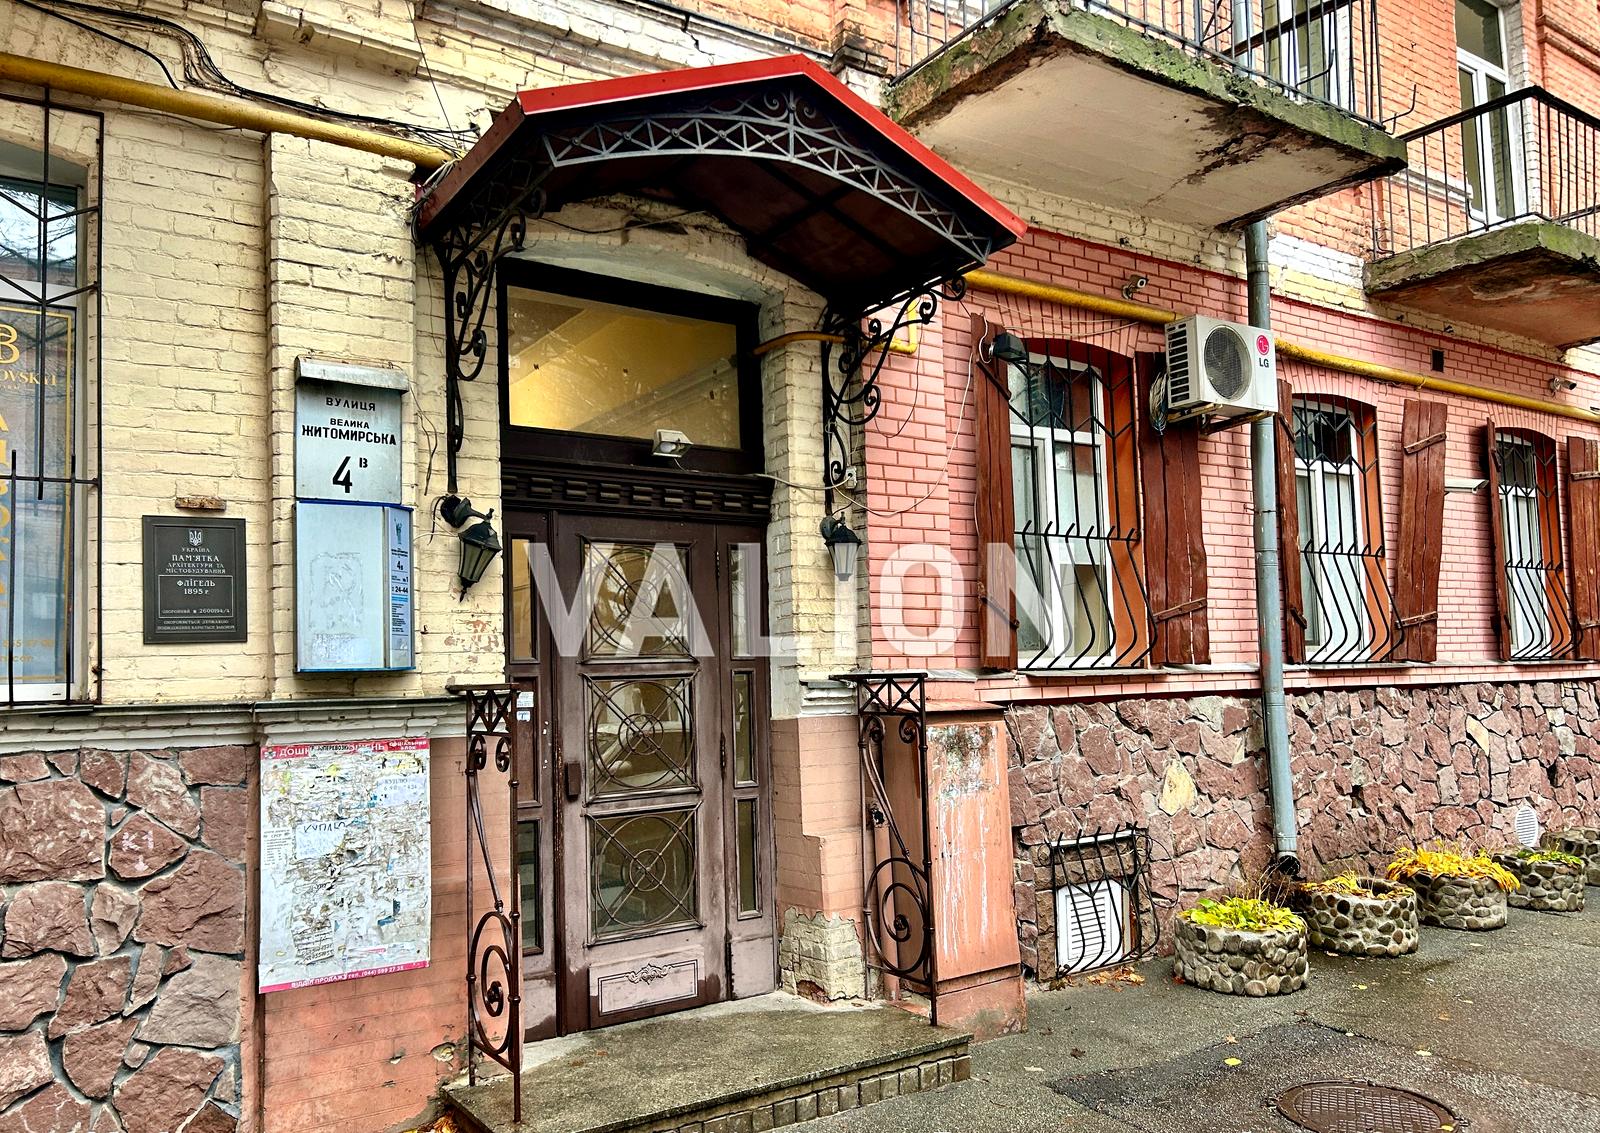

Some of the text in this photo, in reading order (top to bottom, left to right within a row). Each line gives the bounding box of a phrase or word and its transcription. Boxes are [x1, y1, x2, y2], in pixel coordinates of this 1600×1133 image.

[1259, 358, 1270, 368] LG
[326, 397, 376, 411] ВУЛИЦЯ
[330, 418, 370, 429] ВЕЛИКА
[302, 425, 397, 446] ЖИТОМИРСЬКА
[171, 554, 220, 563] ПАМ'ЯТКА
[176, 578, 216, 587] ФЛІГЕЛЬ
[315, 974, 347, 984] ПРОДАЖУ
